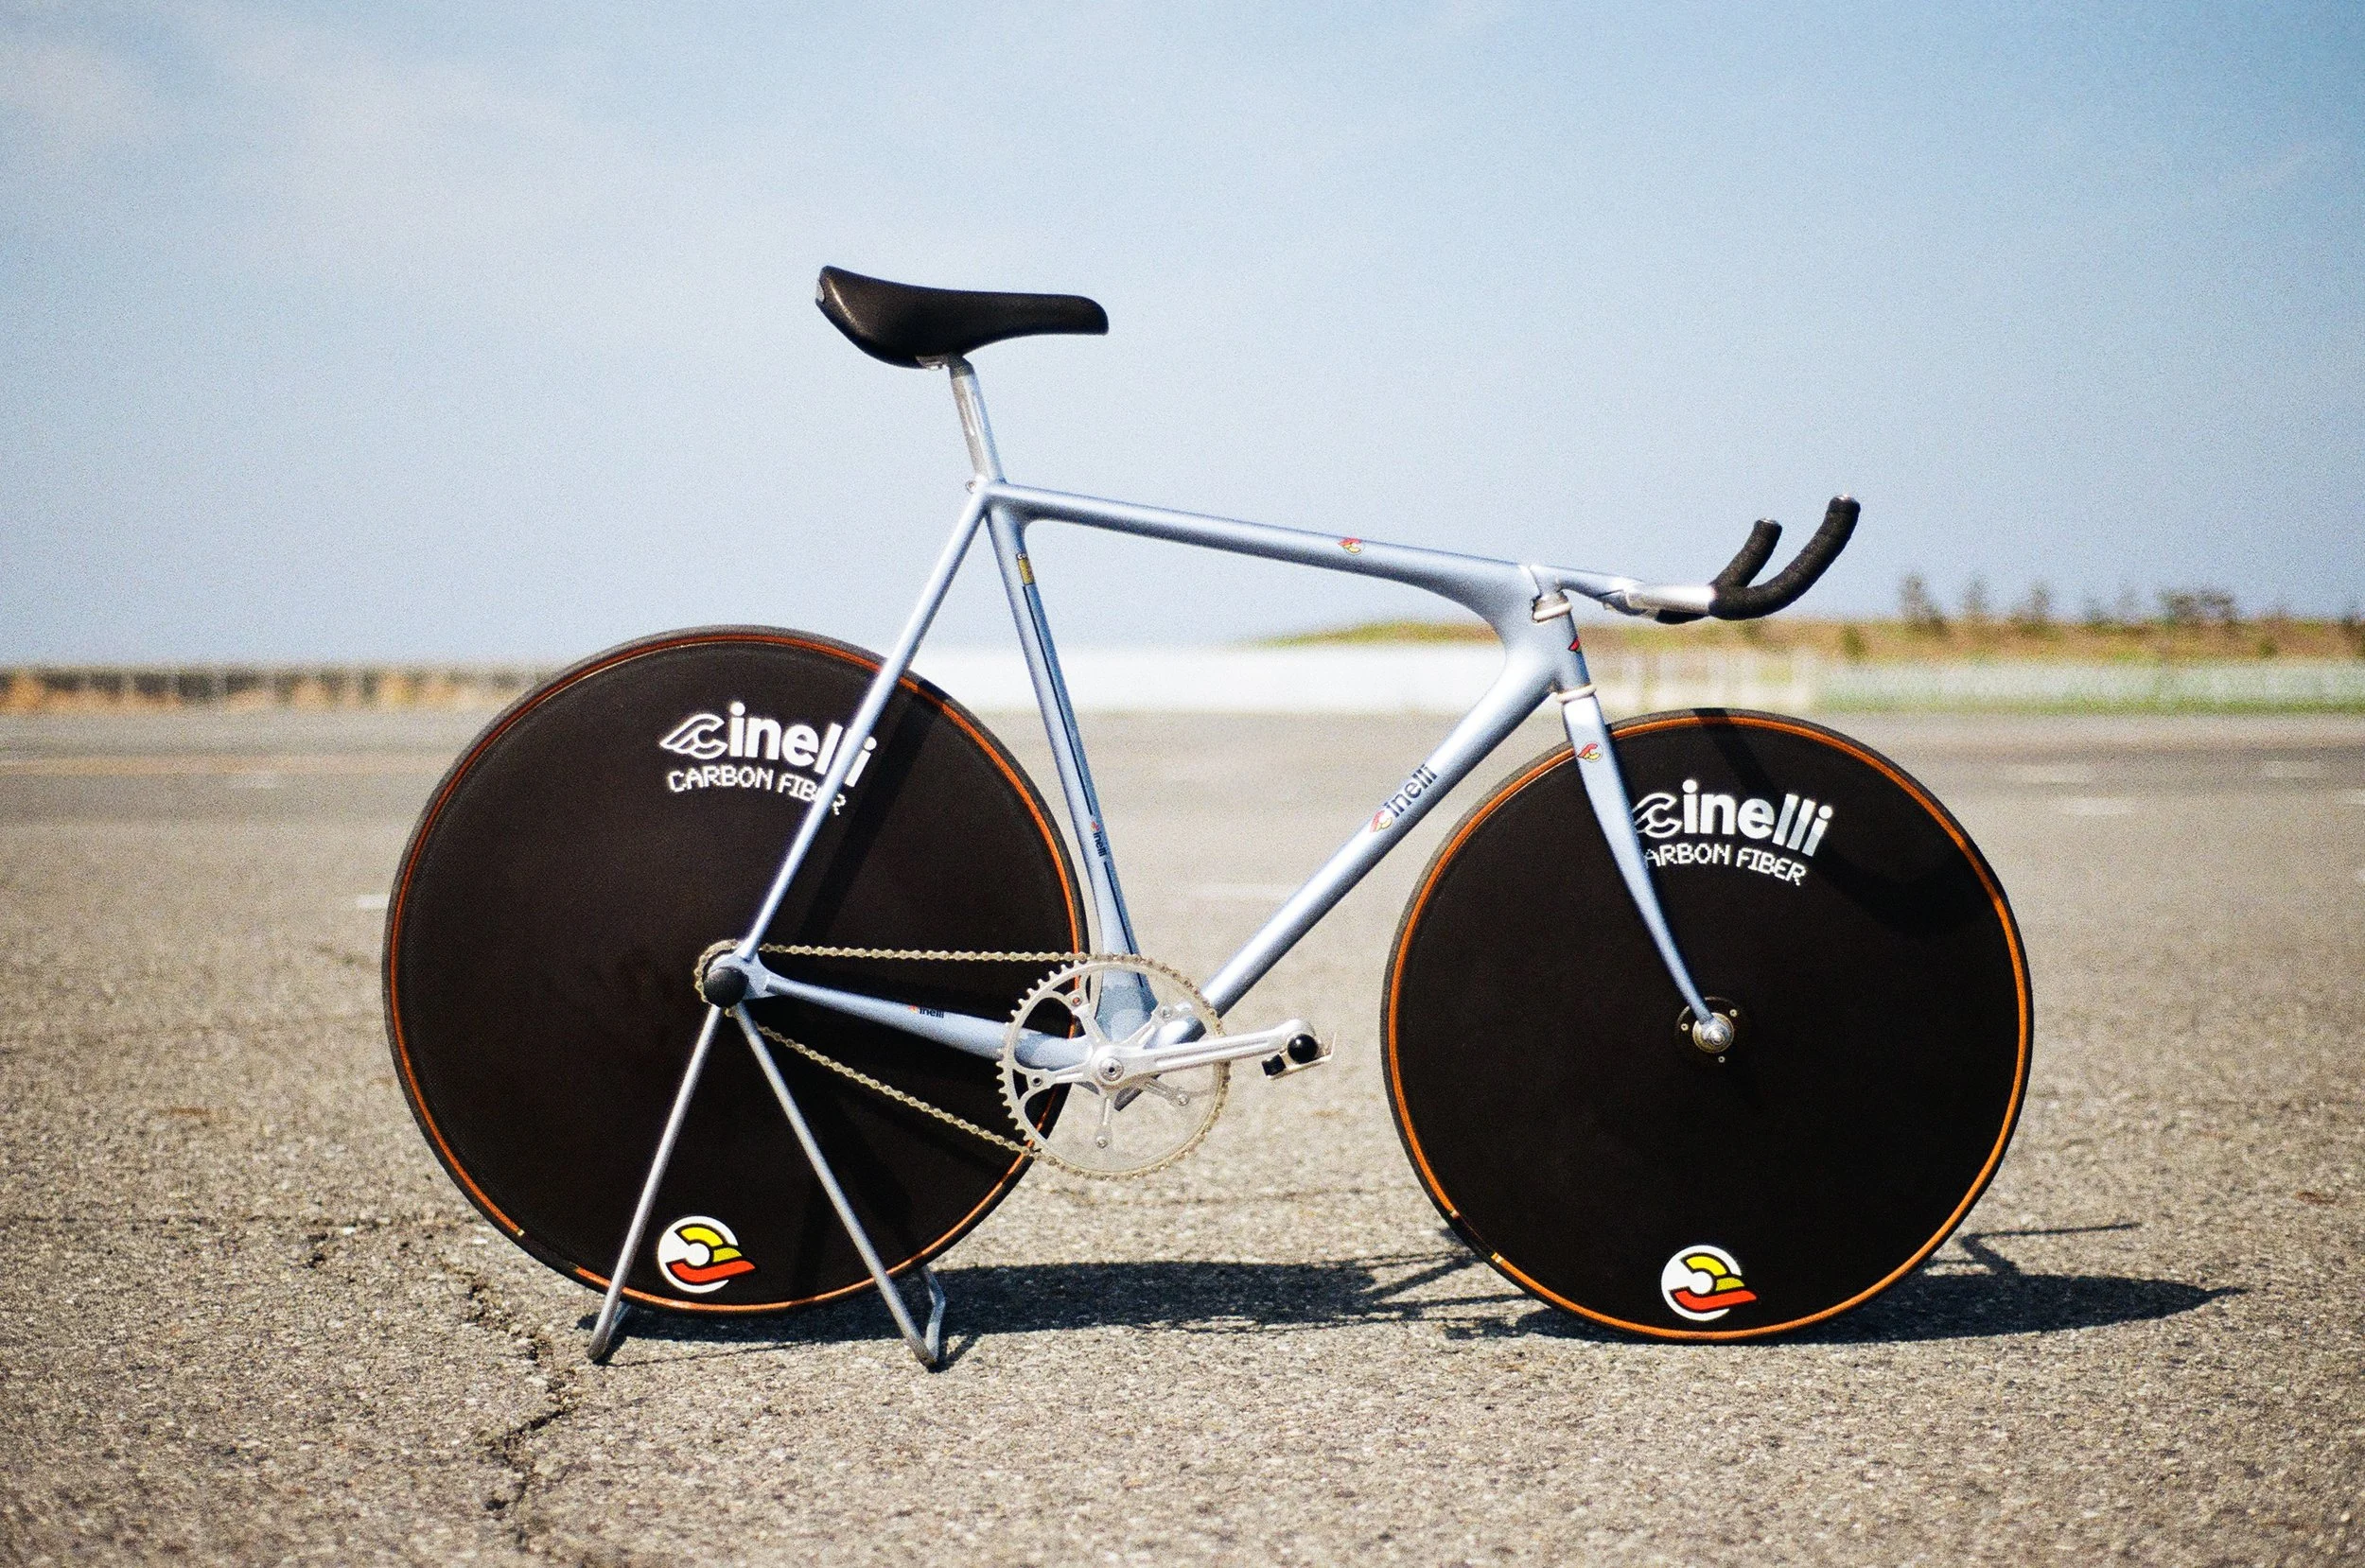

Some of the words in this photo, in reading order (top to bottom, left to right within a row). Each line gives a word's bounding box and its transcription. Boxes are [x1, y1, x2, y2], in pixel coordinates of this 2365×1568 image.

[659, 702, 877, 787] Cineli
[667, 764, 774, 793] CARBON
[777, 772, 847, 815] FIBR
[1369, 763, 1438, 833] Cinelli
[1631, 778, 1833, 857] Cinelli
[1642, 843, 1730, 867] ARBON
[1736, 846, 1807, 886] FIBER
